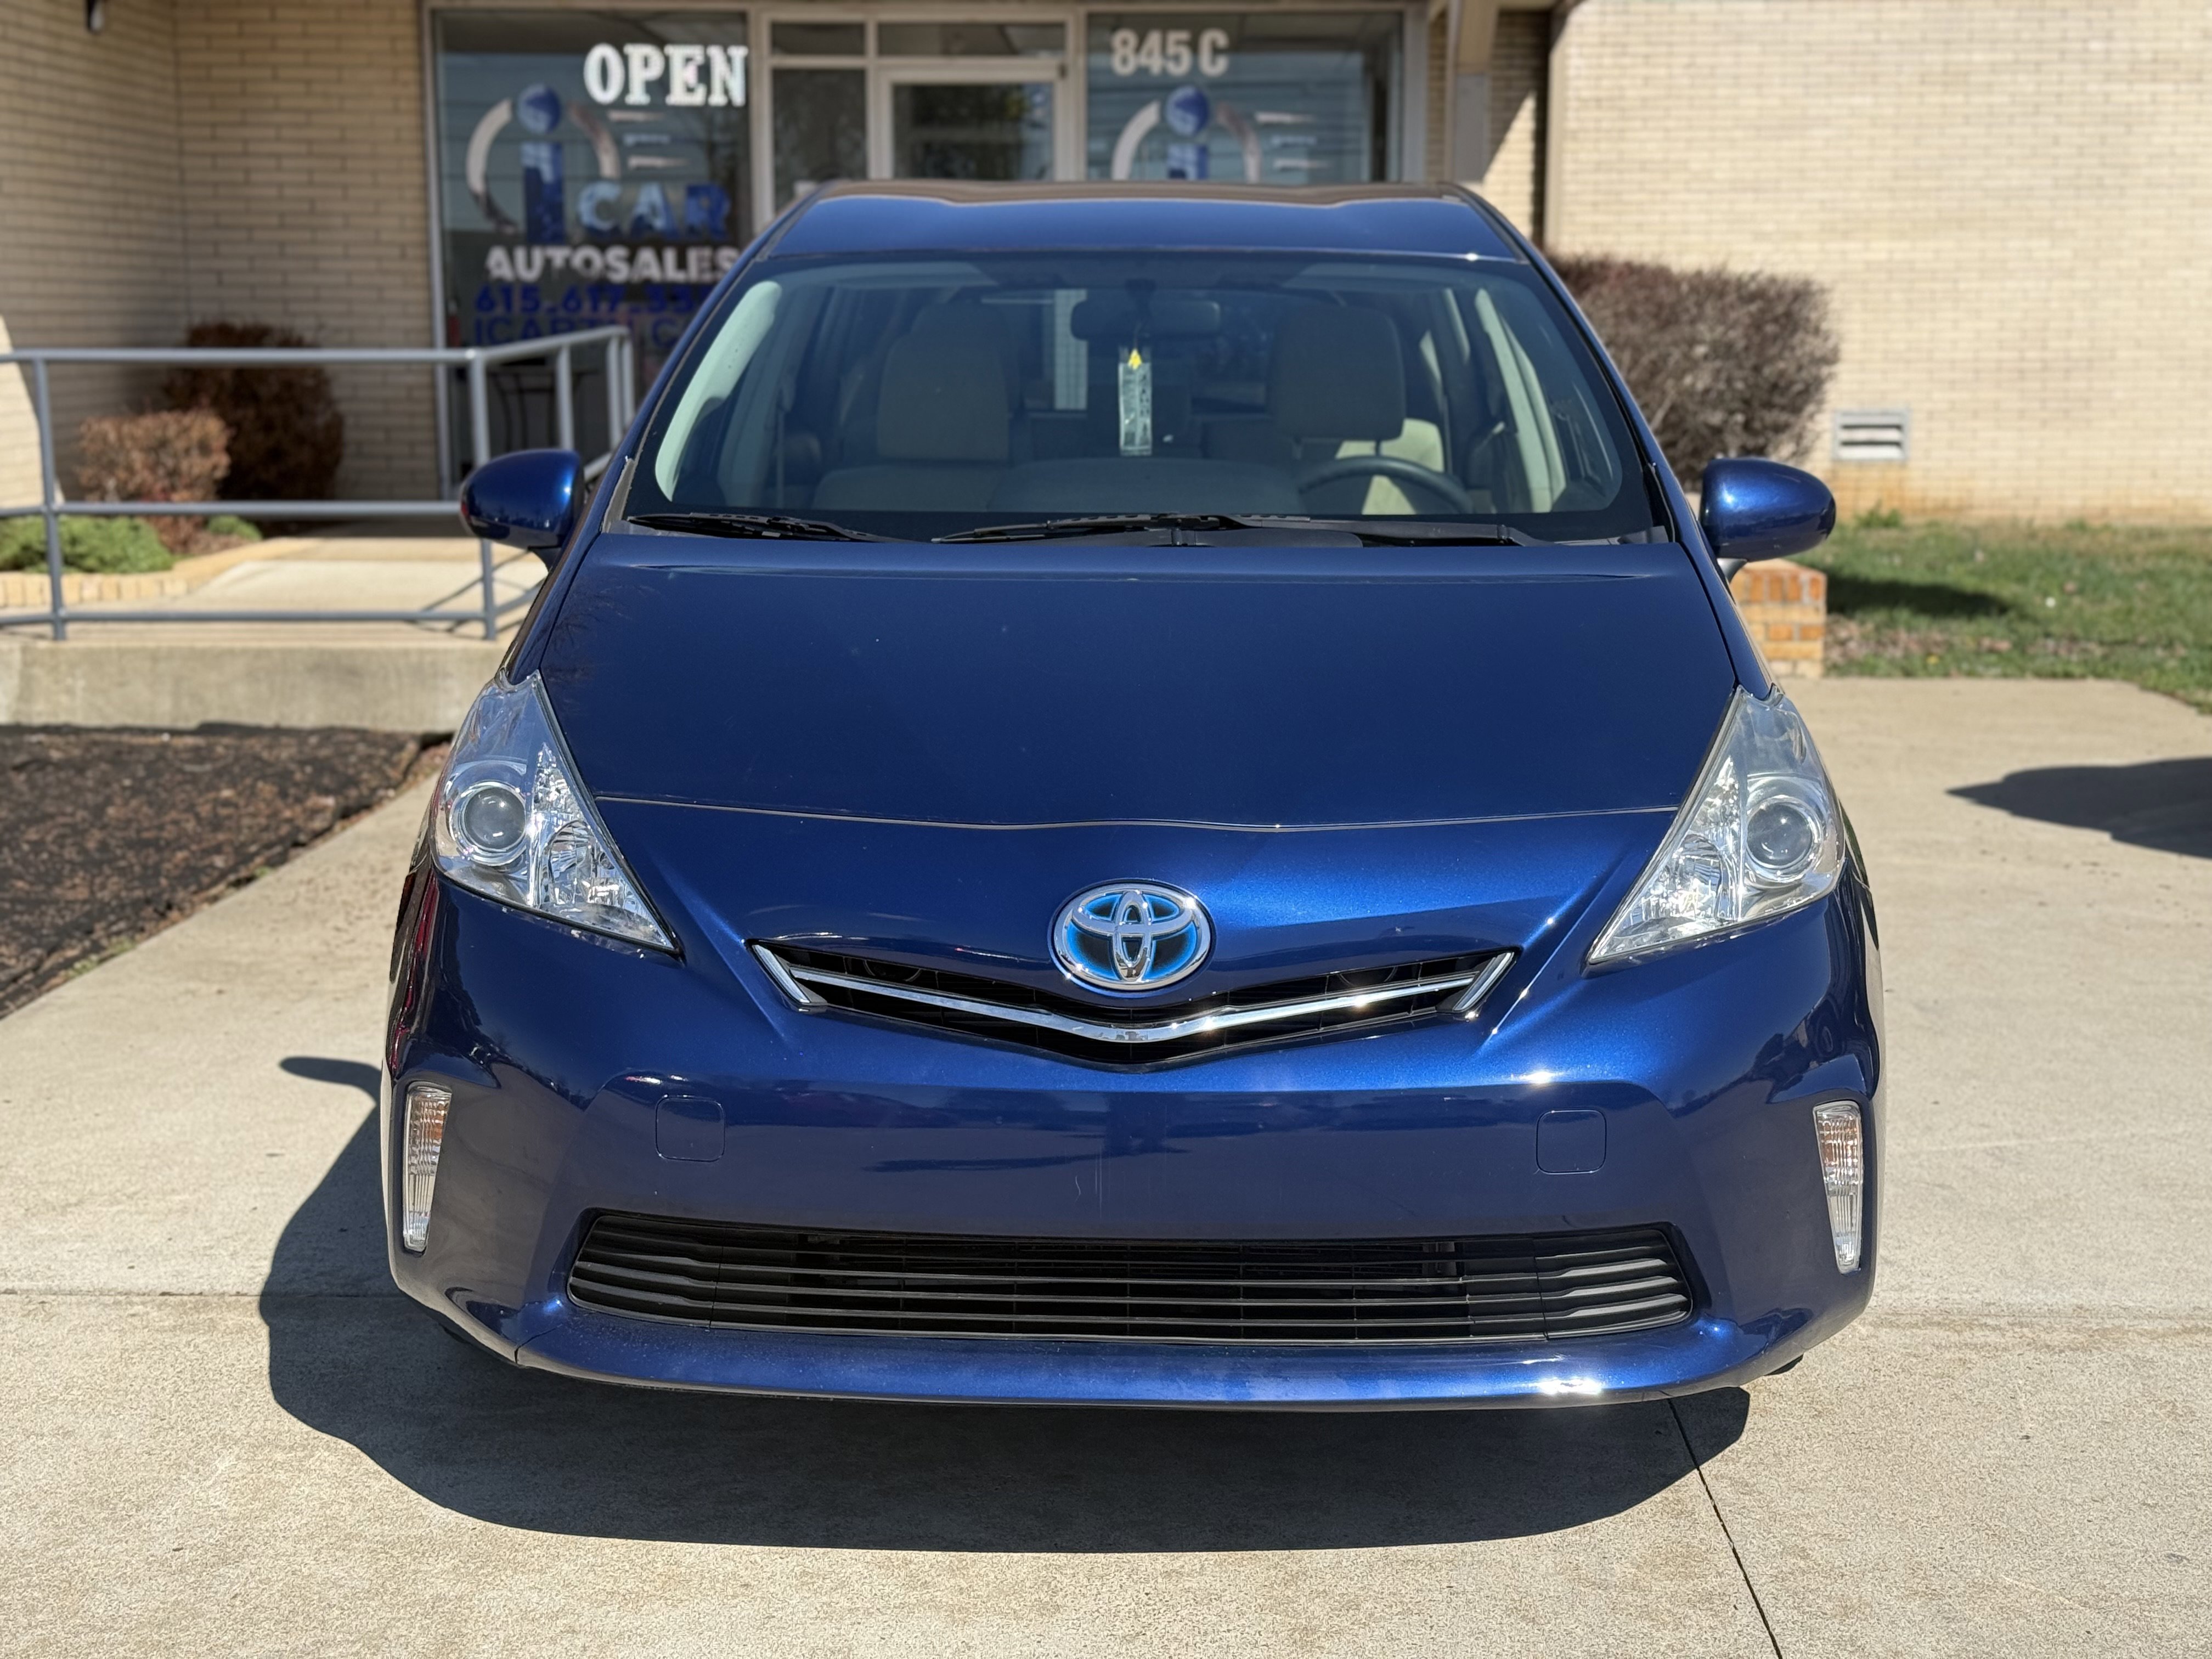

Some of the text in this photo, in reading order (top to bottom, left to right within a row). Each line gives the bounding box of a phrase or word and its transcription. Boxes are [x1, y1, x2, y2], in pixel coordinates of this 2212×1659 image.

[584, 43, 748, 106] OPEN
[1110, 29, 1229, 76] 845 C
[486, 245, 741, 283] AUTOSALES
